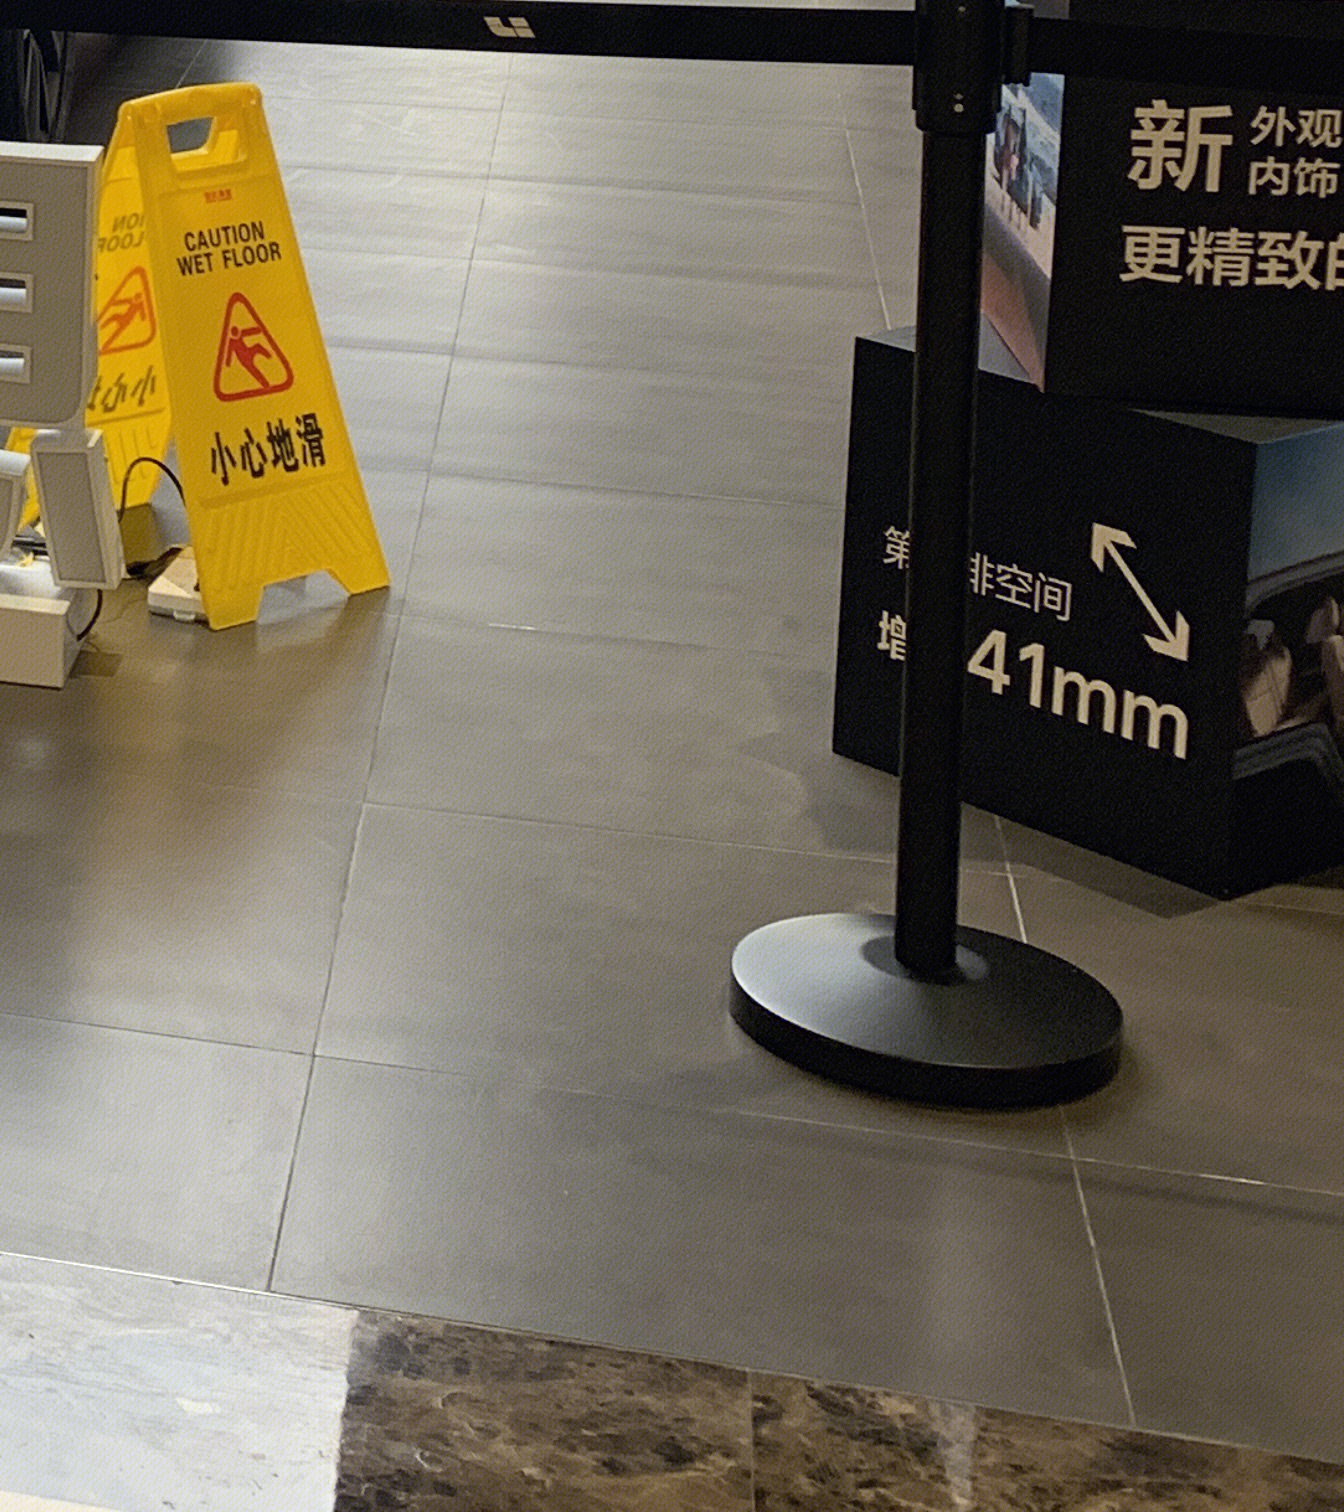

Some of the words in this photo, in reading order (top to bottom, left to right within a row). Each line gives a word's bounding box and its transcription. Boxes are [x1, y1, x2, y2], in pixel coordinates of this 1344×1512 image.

[1127, 99, 1233, 193] 新
[1250, 105, 1343, 148] 外观
[1248, 156, 1341, 199] 内饰
[184, 221, 265, 252] CAUTION
[176, 252, 213, 276] WET
[222, 241, 282, 269] FLOOR
[211, 413, 325, 486] 小心地滑
